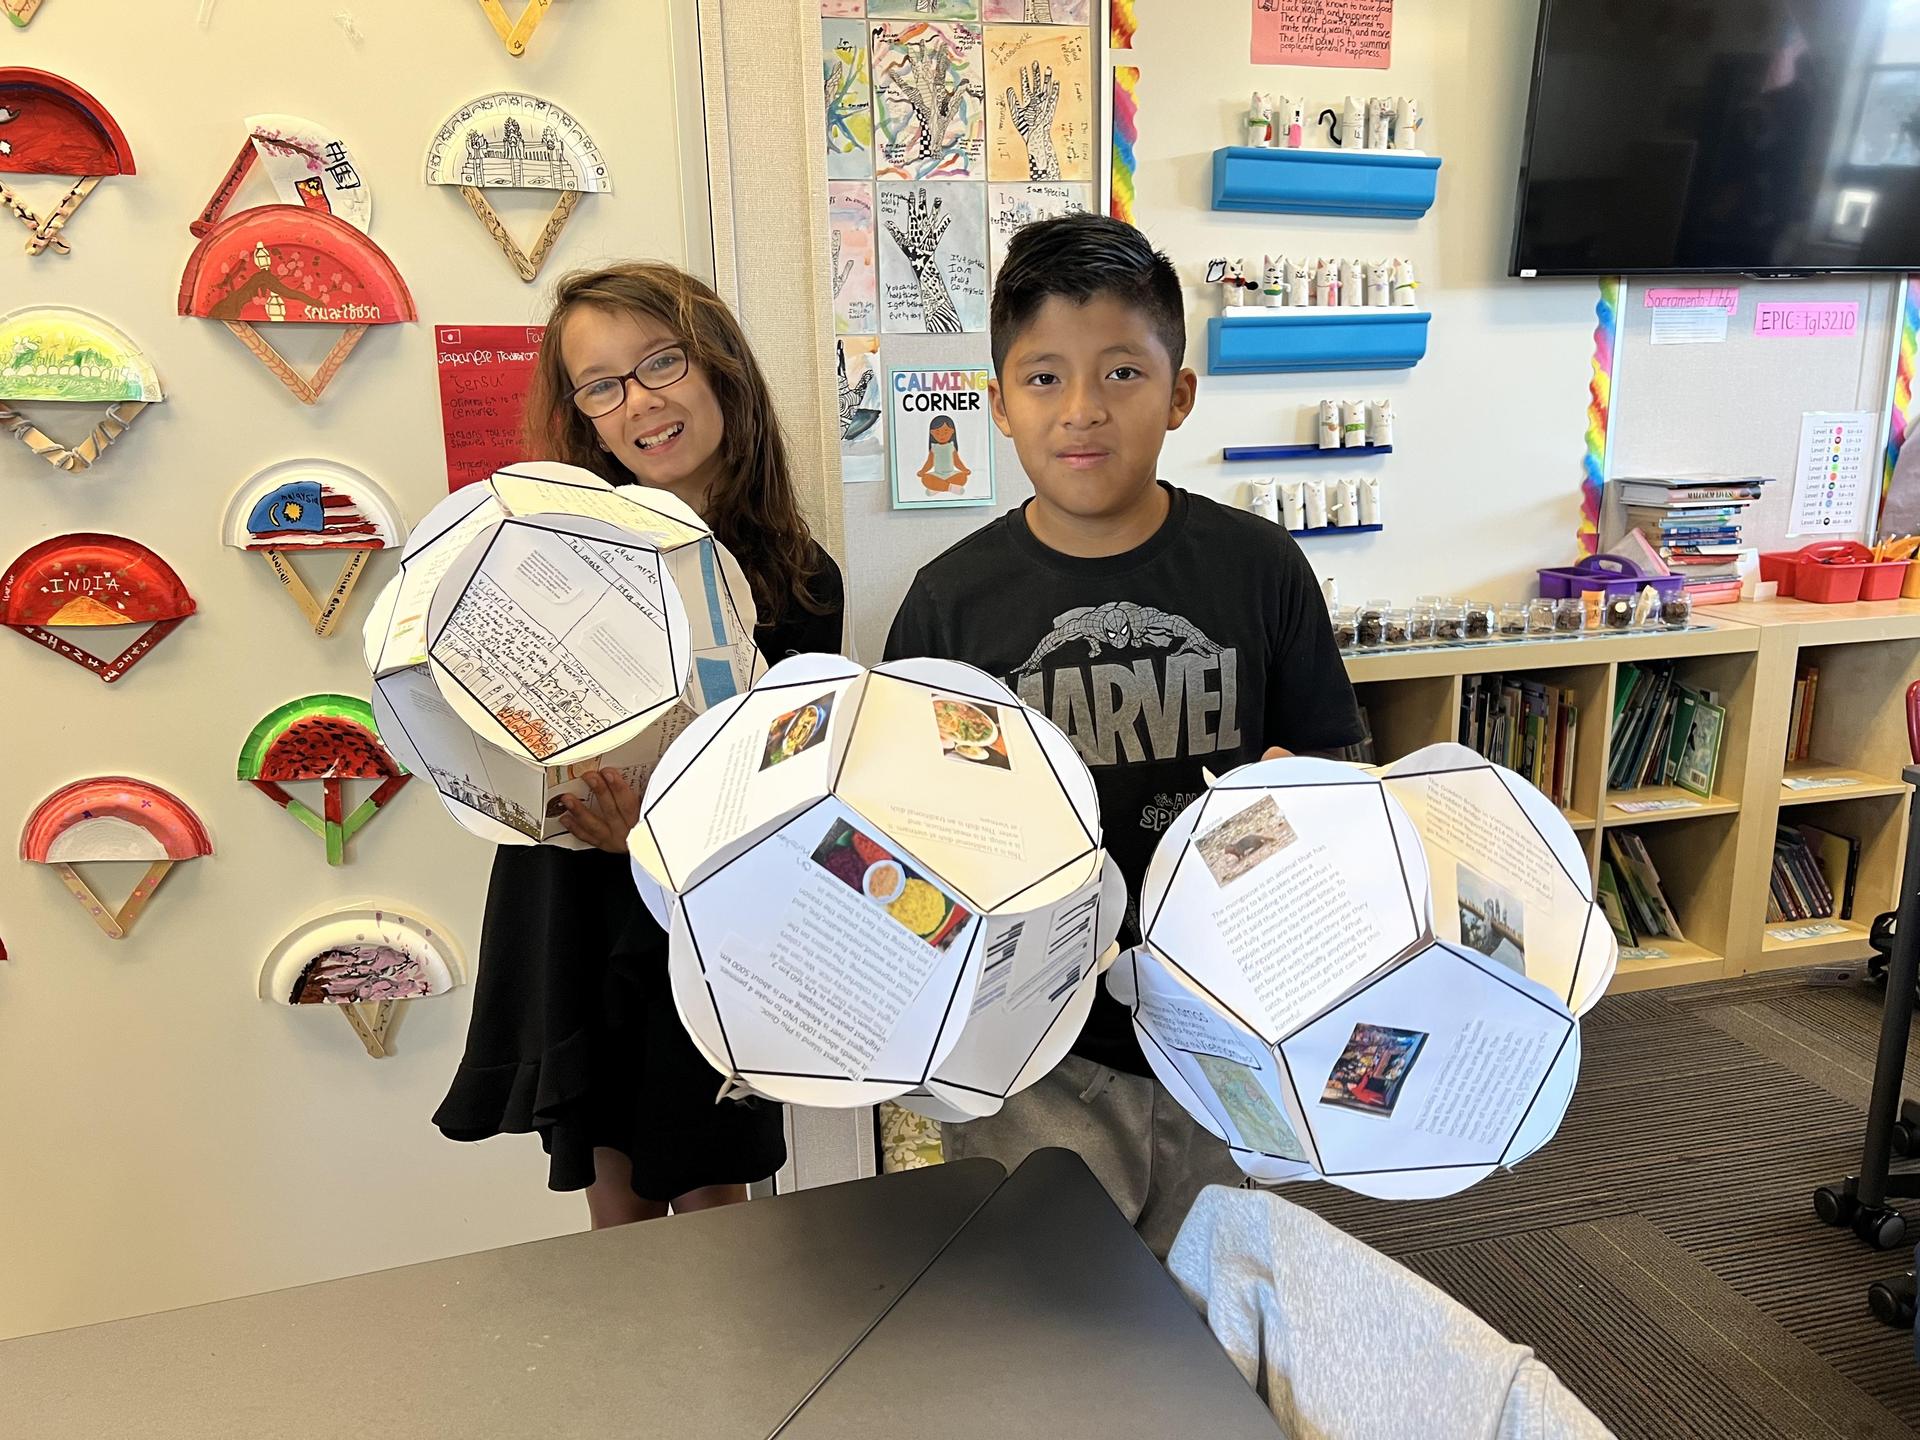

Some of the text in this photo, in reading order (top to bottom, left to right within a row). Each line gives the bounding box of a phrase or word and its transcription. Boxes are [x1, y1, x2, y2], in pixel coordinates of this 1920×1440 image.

[1281, 12, 1295, 23] The
[1296, 14, 1318, 27] right
[1280, 33, 1390, 50] The left paw is to summon
[894, 372, 988, 392] CALMING
[902, 392, 980, 412] CORNER
[50, 576, 120, 593] INDIA
[1000, 648, 1242, 766] MARVEL
[907, 809, 945, 823] traditional
[1211, 909, 1224, 920] The
[1226, 887, 1258, 910] mongoose
[1276, 861, 1298, 878] animal
[1298, 852, 1313, 863] that
[1313, 845, 1326, 854] has
[1217, 918, 1228, 928] the
[1230, 906, 1249, 920] ability
[1268, 878, 1290, 895] snakes
[1291, 867, 1307, 880] even
[1247, 898, 1279, 921] According
[1287, 885, 1298, 895] the
[1299, 875, 1313, 886] text
[1313, 866, 1328, 877] that
[780, 930, 802, 947] colors
[802, 946, 814, 957] the
[732, 961, 750, 977] 5000
[815, 954, 844, 978] because
[751, 973, 772, 990] about
[843, 974, 871, 995] colorful
[754, 990, 774, 1005] make
[779, 993, 793, 1004] and
[783, 1010, 798, 1024] VND
[794, 1001, 822, 1026] Mekong
[885, 1002, 900, 1016] that
[780, 1021, 795, 1034] Phu
[799, 1021, 817, 1036] 1000
[837, 1018, 854, 1032] peak
[818, 1033, 839, 1050] about
[829, 1028, 846, 1041] river
[801, 1036, 823, 1054] island
[823, 1051, 847, 1071] largest
[840, 1048, 861, 1065] needs
